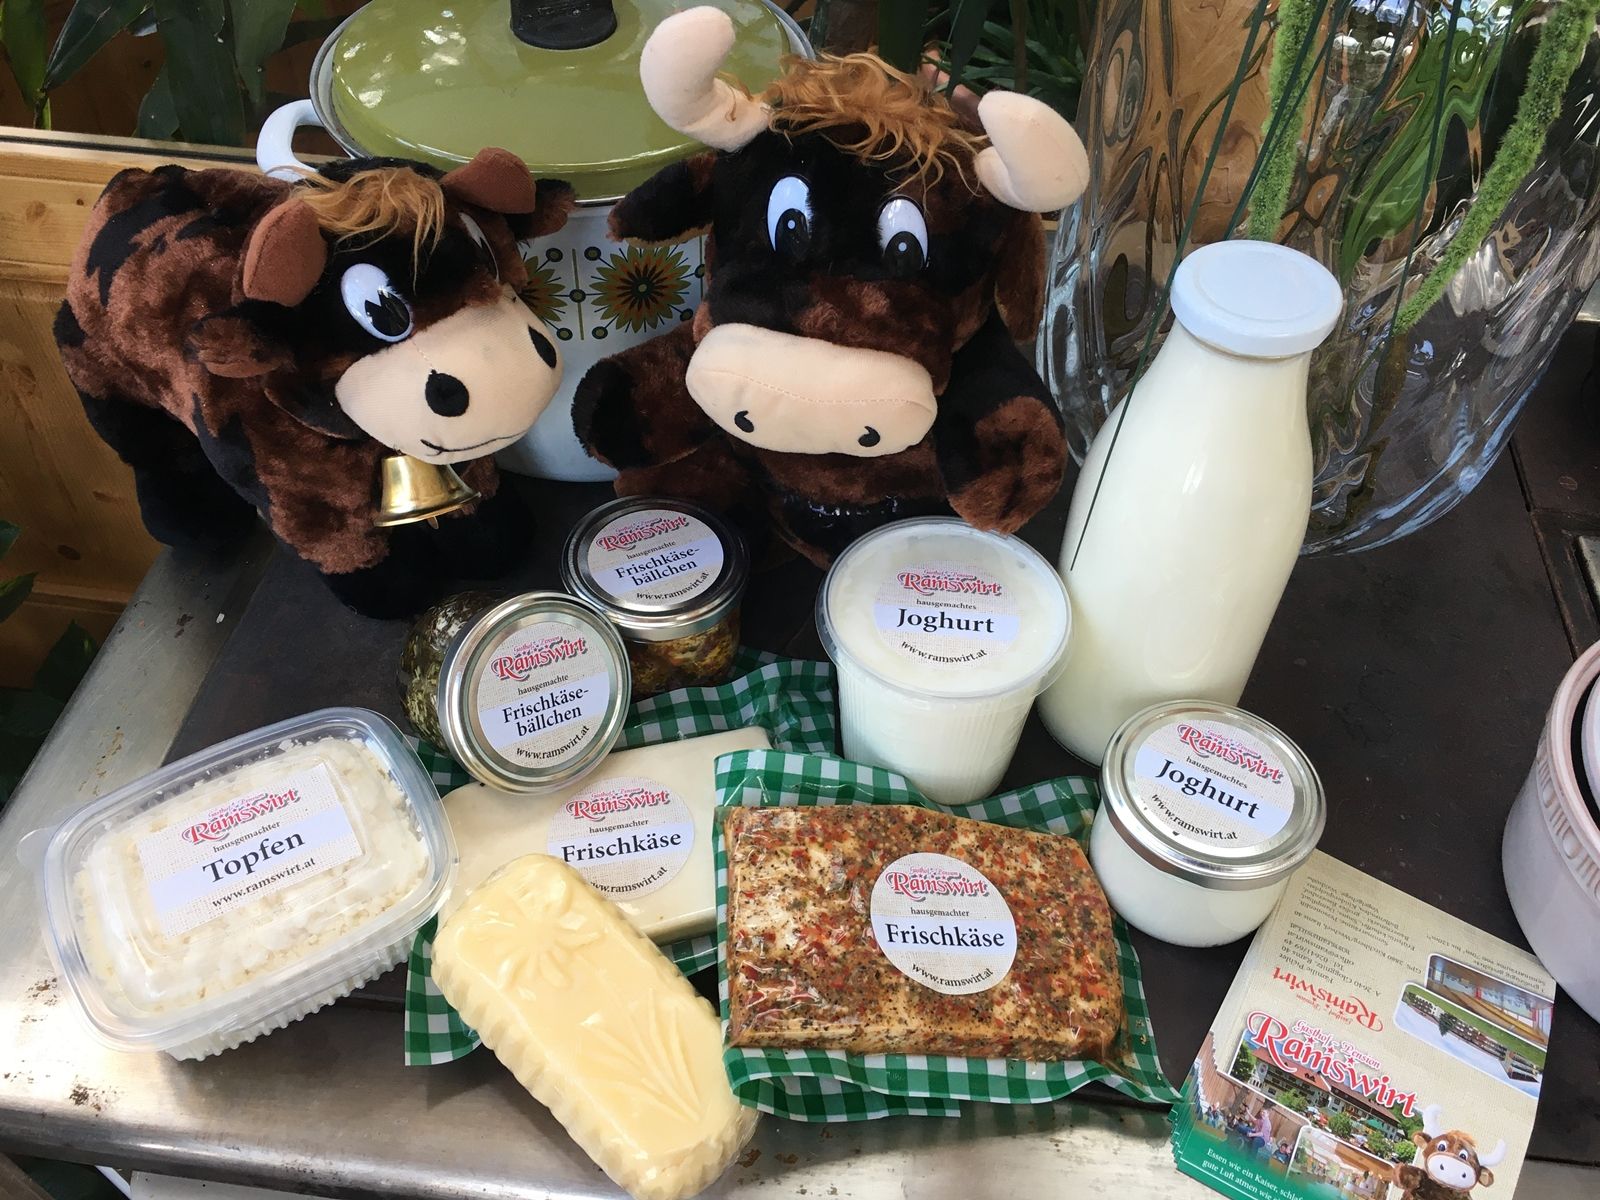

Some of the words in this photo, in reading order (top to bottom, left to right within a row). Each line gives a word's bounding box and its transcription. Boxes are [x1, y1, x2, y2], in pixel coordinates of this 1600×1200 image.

[597, 515, 689, 551] Ramswirt
[615, 547, 700, 578] Frischkäse-
[626, 540, 676, 560] hausgemachte
[633, 560, 698, 586] bällchen
[636, 572, 709, 600] www.ramswirt.at
[897, 572, 1002, 596] Ramswirt
[897, 608, 994, 632] Joghurt
[916, 599, 977, 610] hausgemachtes
[491, 637, 588, 682] Ramswirt
[901, 641, 987, 663] www.ramswirt.at
[518, 674, 569, 695] hausgemachte
[503, 687, 589, 723] Frischkäse-
[517, 706, 582, 736] bällchen
[517, 725, 589, 759] www.ramswirt.at
[1177, 724, 1284, 784] Ramswirt
[1186, 756, 1248, 789] hausgemachtes
[1155, 759, 1260, 819] Joghurt
[181, 788, 300, 845] Ramswirt
[566, 789, 671, 822] Ramswirt
[1151, 794, 1238, 840] www.ramswirt.at
[213, 821, 281, 853] hausgemachter
[589, 819, 649, 834] hausgemachter
[202, 833, 305, 883] Topfen
[561, 833, 681, 863] Frischkäse
[212, 857, 316, 908] www.ramswirt.at
[885, 871, 989, 902] Ramswirt
[910, 907, 970, 918] hausgemachter
[885, 923, 1005, 947] Frischkäse
[912, 963, 993, 987] www.ramswirt.at
[1272, 967, 1384, 1031] Ramswirt
[1294, 1020, 1333, 1047] Gasthof
[1342, 1041, 1381, 1069] Pension
[1247, 1010, 1418, 1117] Ramswirt
[1202, 1159, 1219, 1172] gute
[1219, 1167, 1235, 1180] Luft
[1235, 1177, 1258, 1193] atmen
[1207, 1148, 1227, 1164] Essen
[1229, 1161, 1241, 1172] wie
[1242, 1167, 1253, 1179] ein
[1254, 1173, 1278, 1193] Kaiser,
